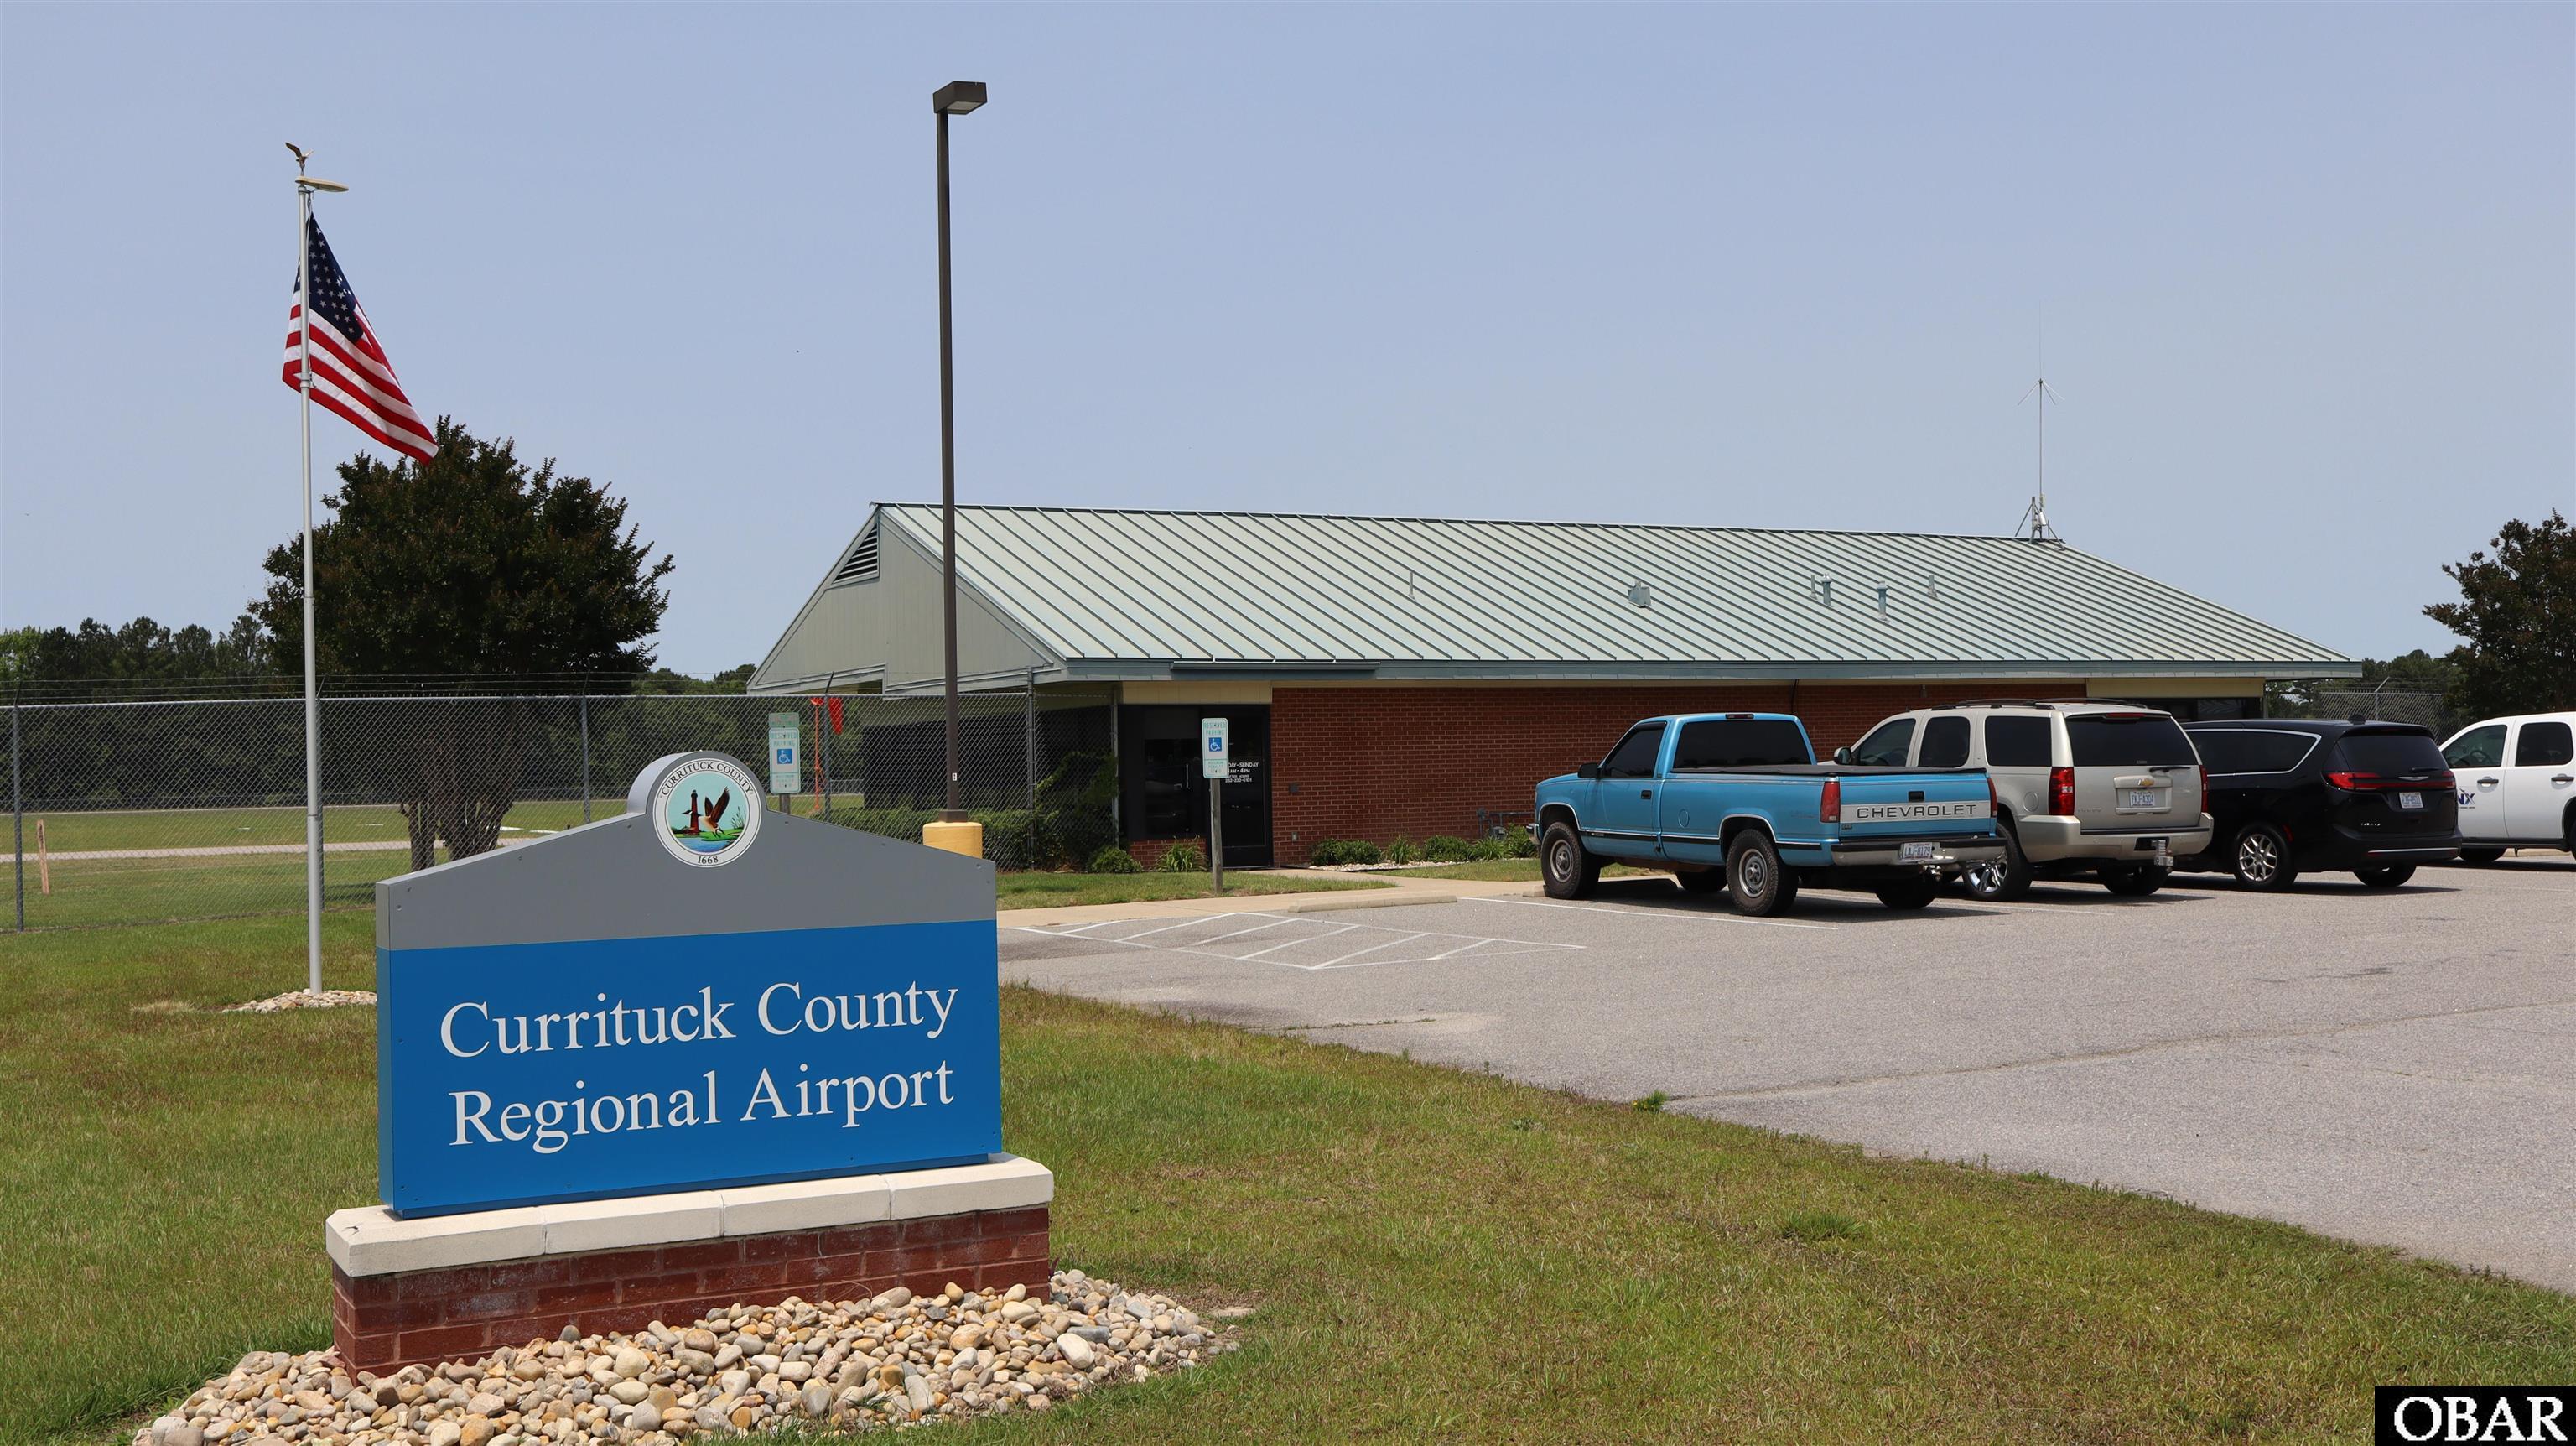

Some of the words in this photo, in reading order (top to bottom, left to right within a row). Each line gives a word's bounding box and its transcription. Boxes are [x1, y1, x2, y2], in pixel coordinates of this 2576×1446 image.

[662, 761, 714, 796] CURRITUCK
[716, 763, 754, 793] COUNTY
[1857, 804, 1976, 819] CHEVROLET
[697, 856, 719, 865] 1668
[440, 986, 737, 1058] Currituck
[757, 980, 959, 1039] County
[448, 1069, 722, 1154] Regional
[740, 1059, 955, 1128] Airport
